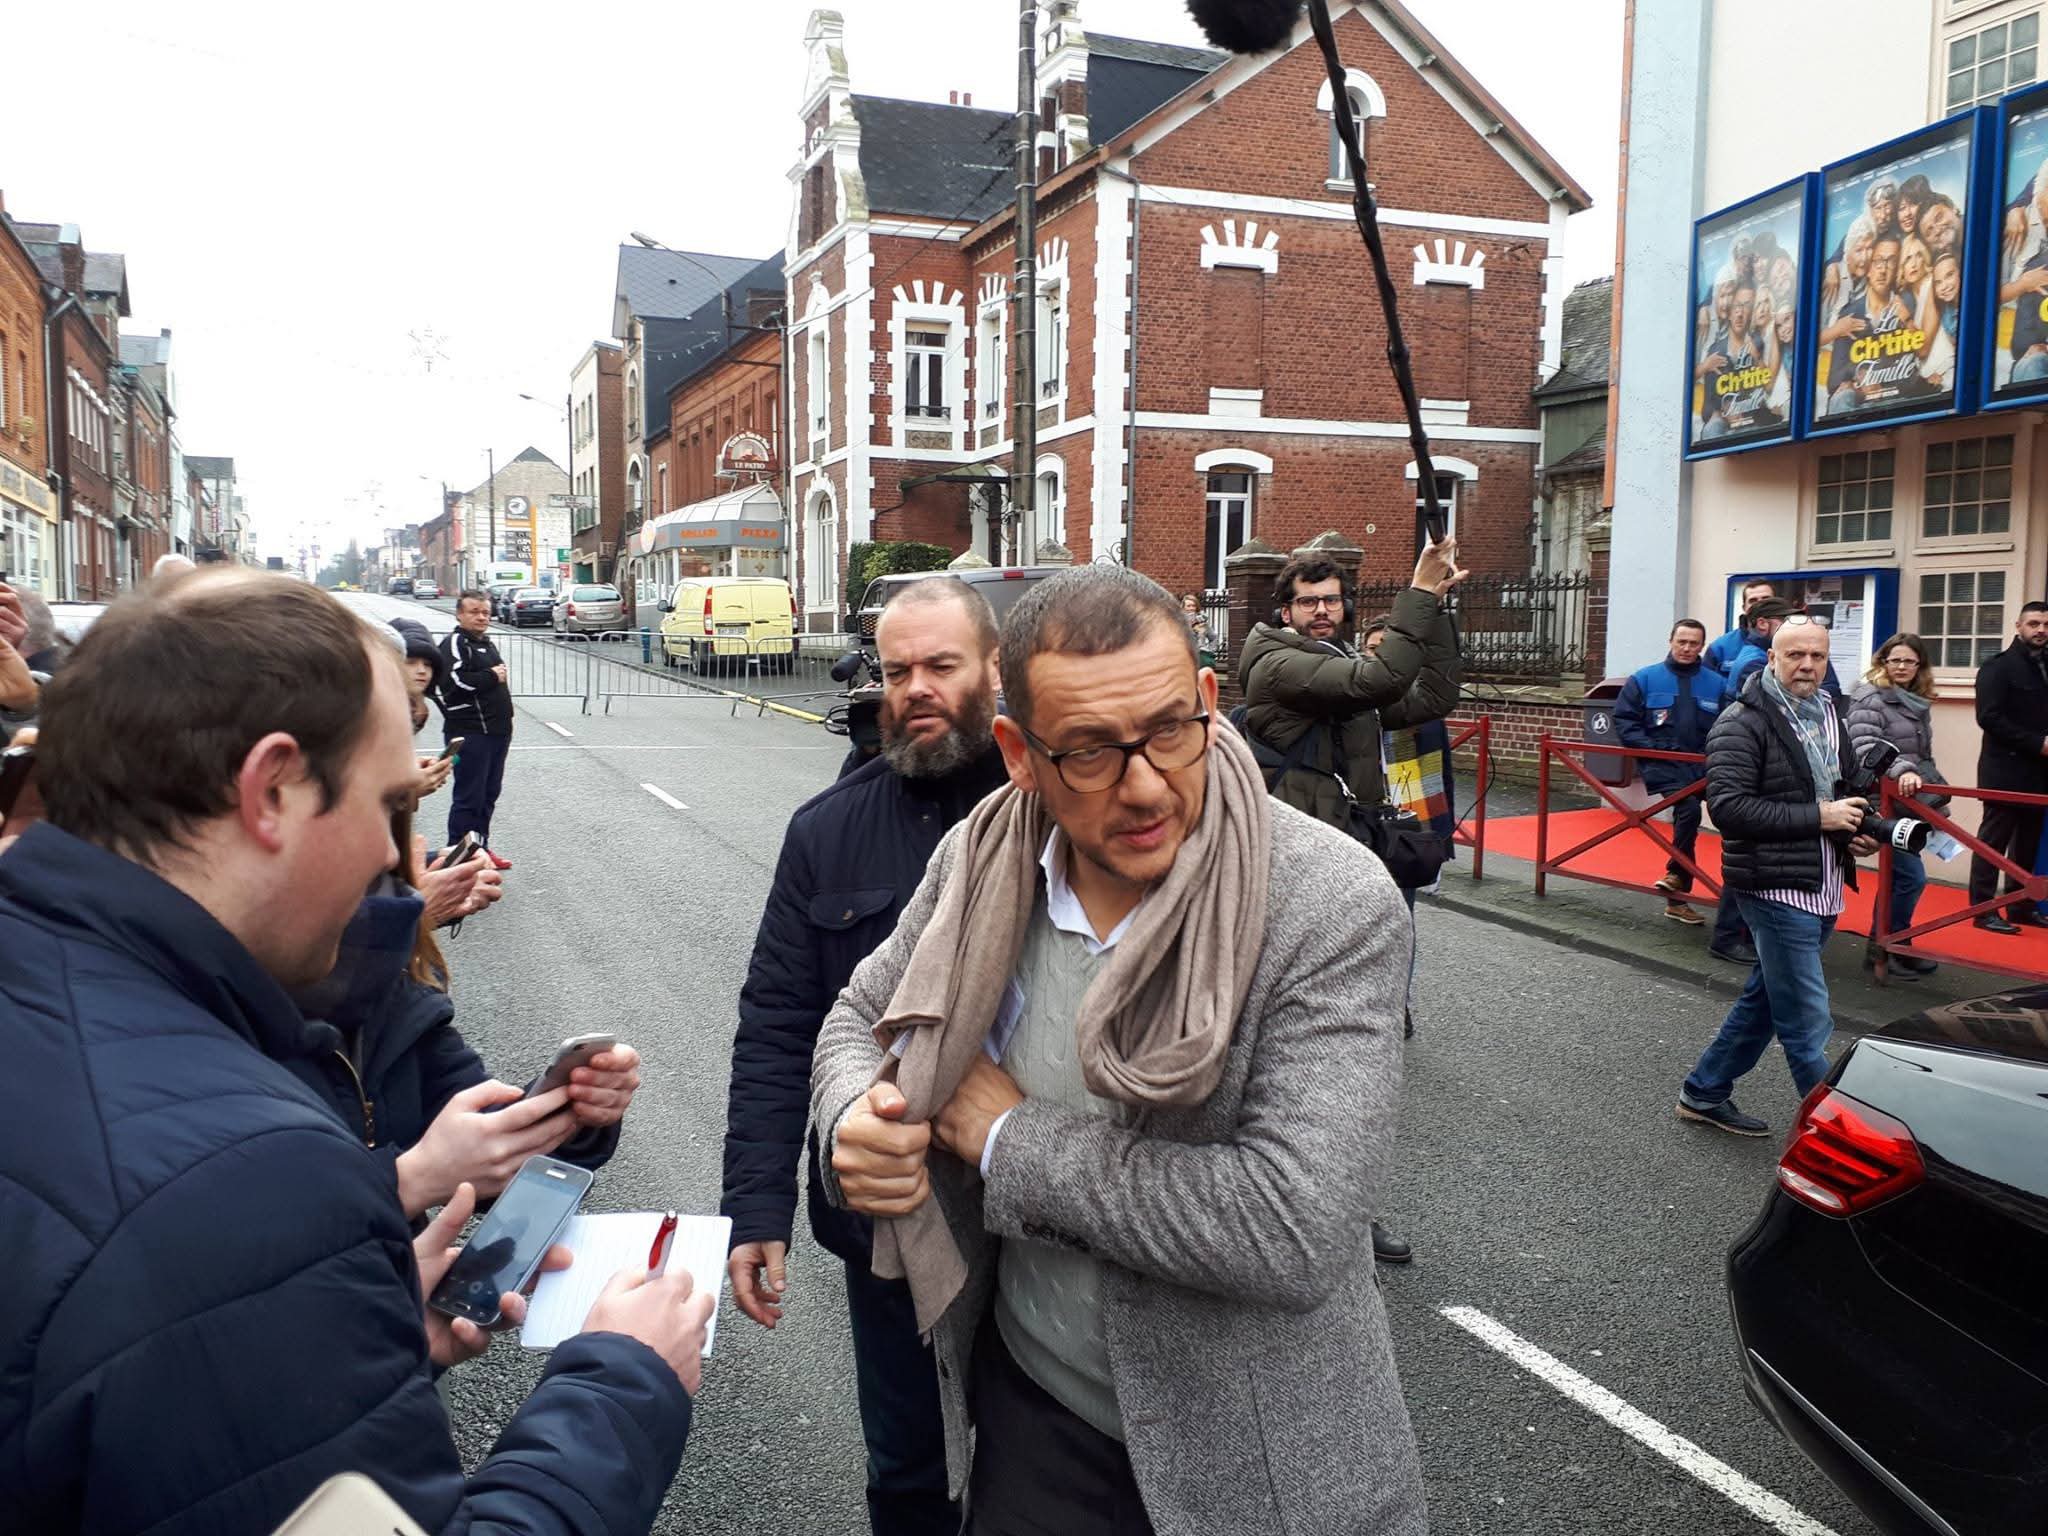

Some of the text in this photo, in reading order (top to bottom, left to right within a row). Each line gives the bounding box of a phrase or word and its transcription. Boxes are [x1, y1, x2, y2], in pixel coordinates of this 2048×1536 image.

[1873, 302, 1901, 334] La
[1734, 341, 1753, 370] La
[1853, 353, 1917, 389] Famille
[1721, 387, 1766, 417] Famille
